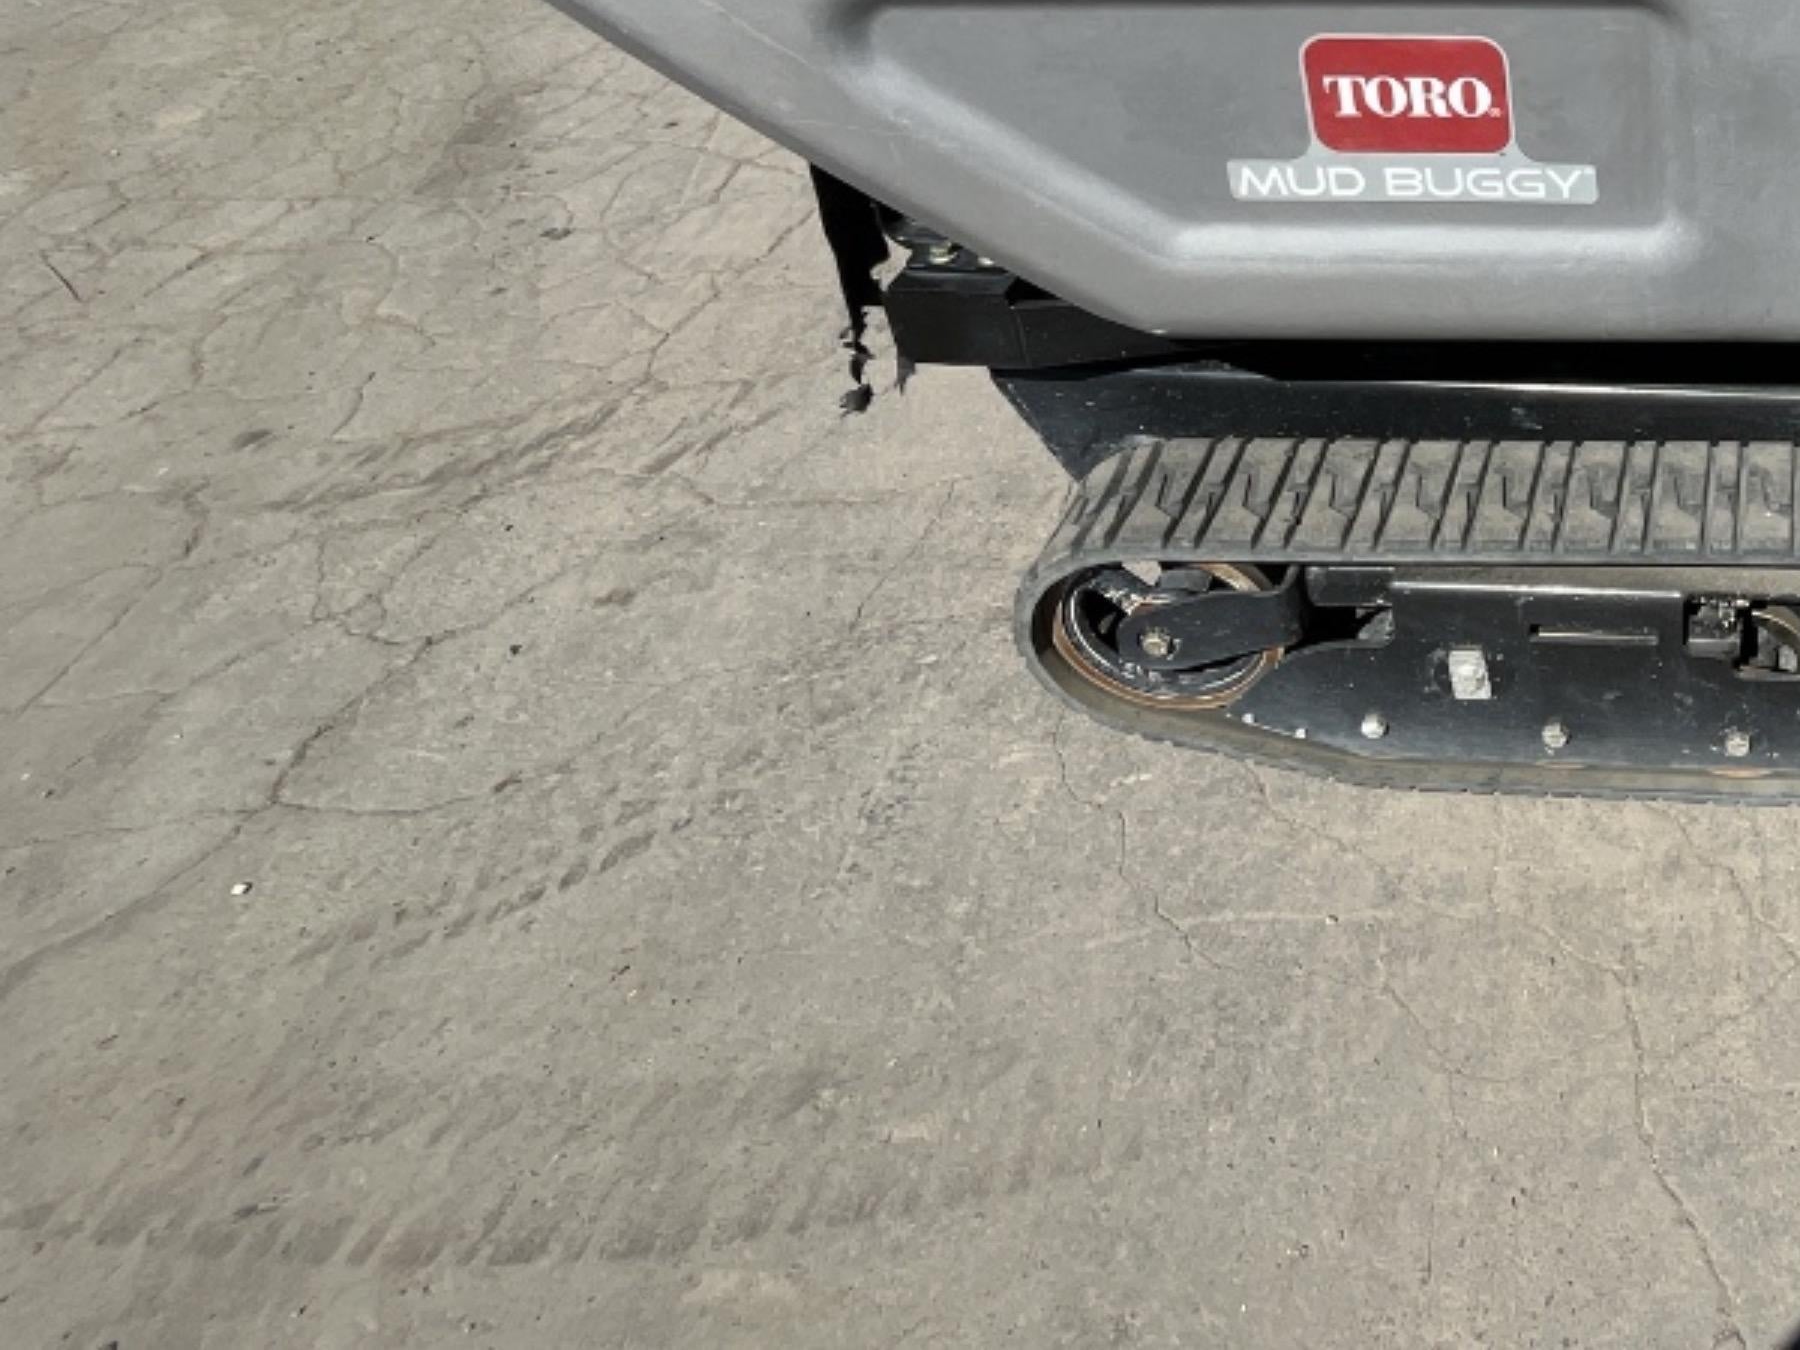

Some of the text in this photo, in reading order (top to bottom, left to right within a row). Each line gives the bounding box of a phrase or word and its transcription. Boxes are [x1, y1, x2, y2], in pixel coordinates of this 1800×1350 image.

[1322, 74, 1493, 118] TORO
[1239, 165, 1592, 201] MUD BUGGY
